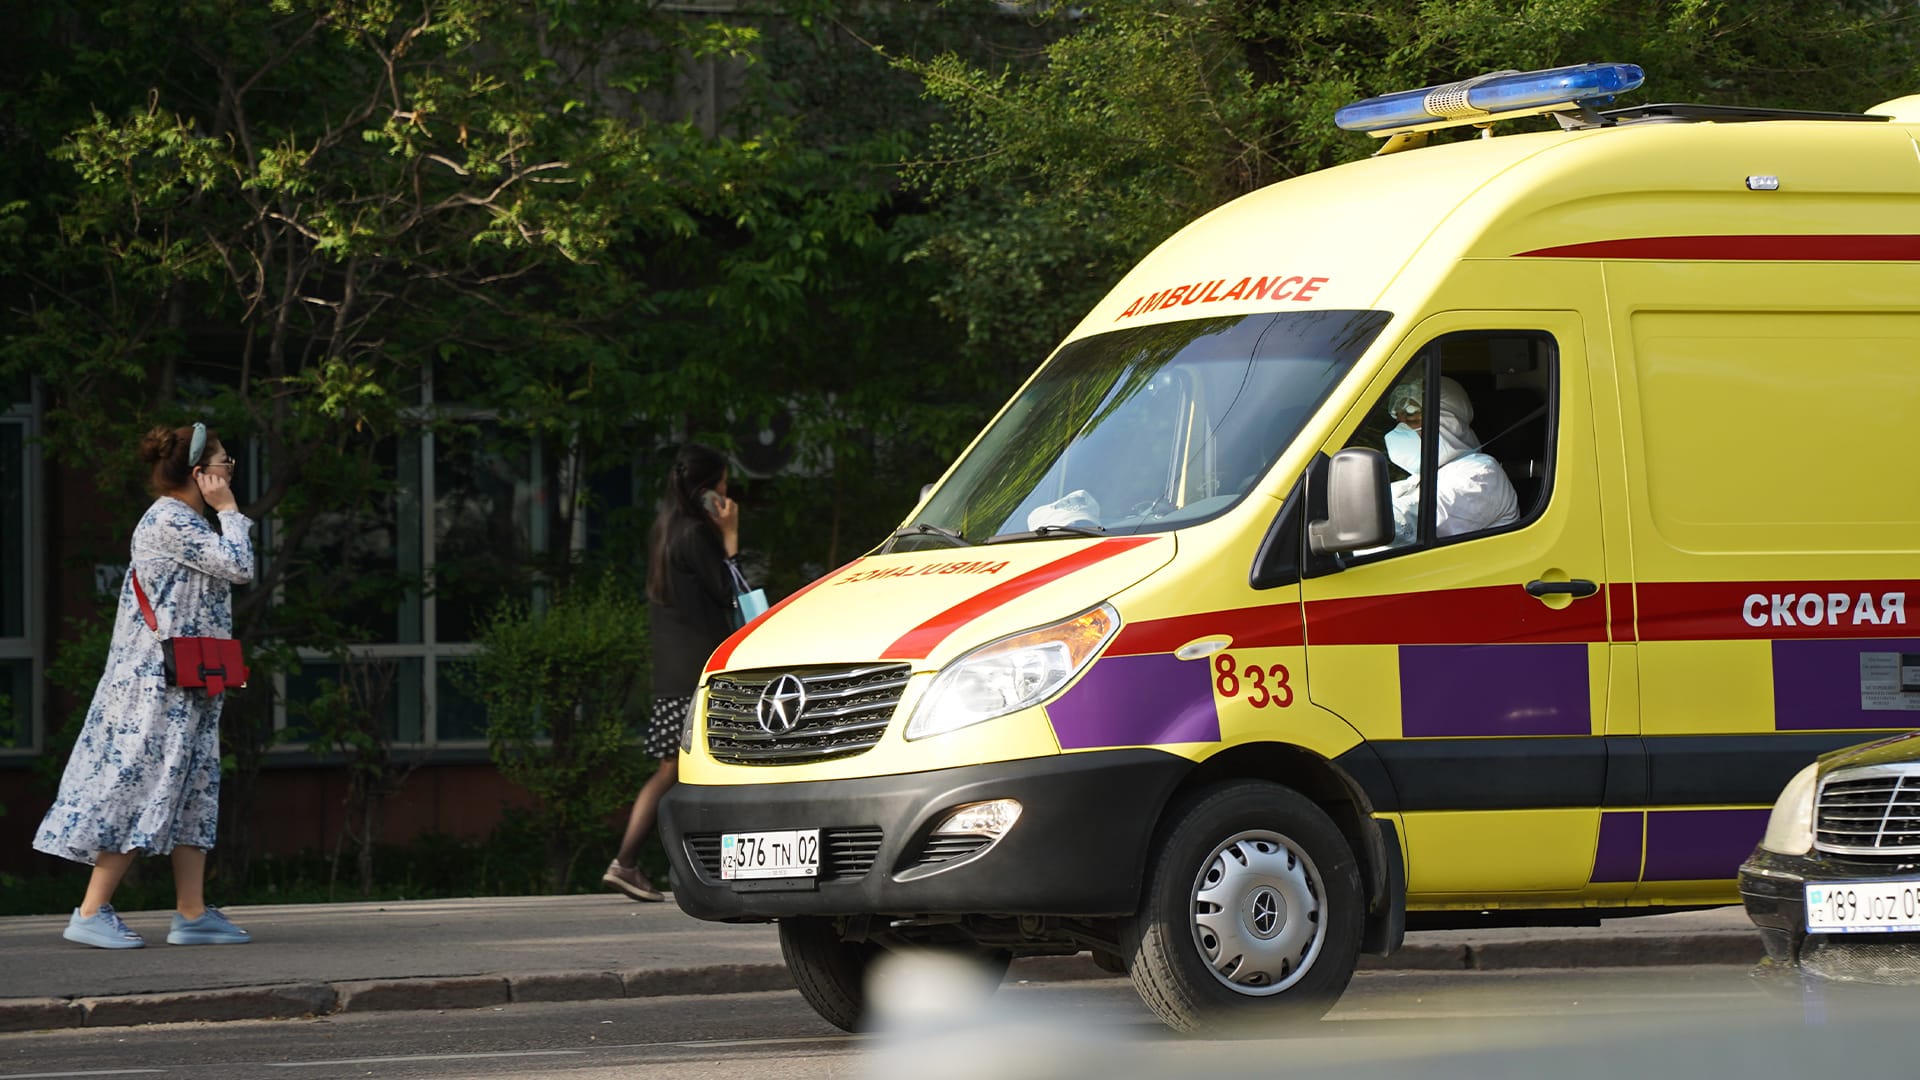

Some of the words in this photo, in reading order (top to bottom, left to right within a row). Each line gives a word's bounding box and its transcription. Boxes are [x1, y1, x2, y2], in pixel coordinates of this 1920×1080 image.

[1114, 276, 1329, 322] AMBULANCE
[1742, 592, 1907, 627] СКОРАЯ
[1214, 653, 1294, 709] 833
[736, 837, 766, 868] 376
[772, 843, 791, 866] TN
[799, 835, 818, 865] 02
[1825, 889, 1858, 921] 189
[1863, 895, 1899, 920] JOZ
